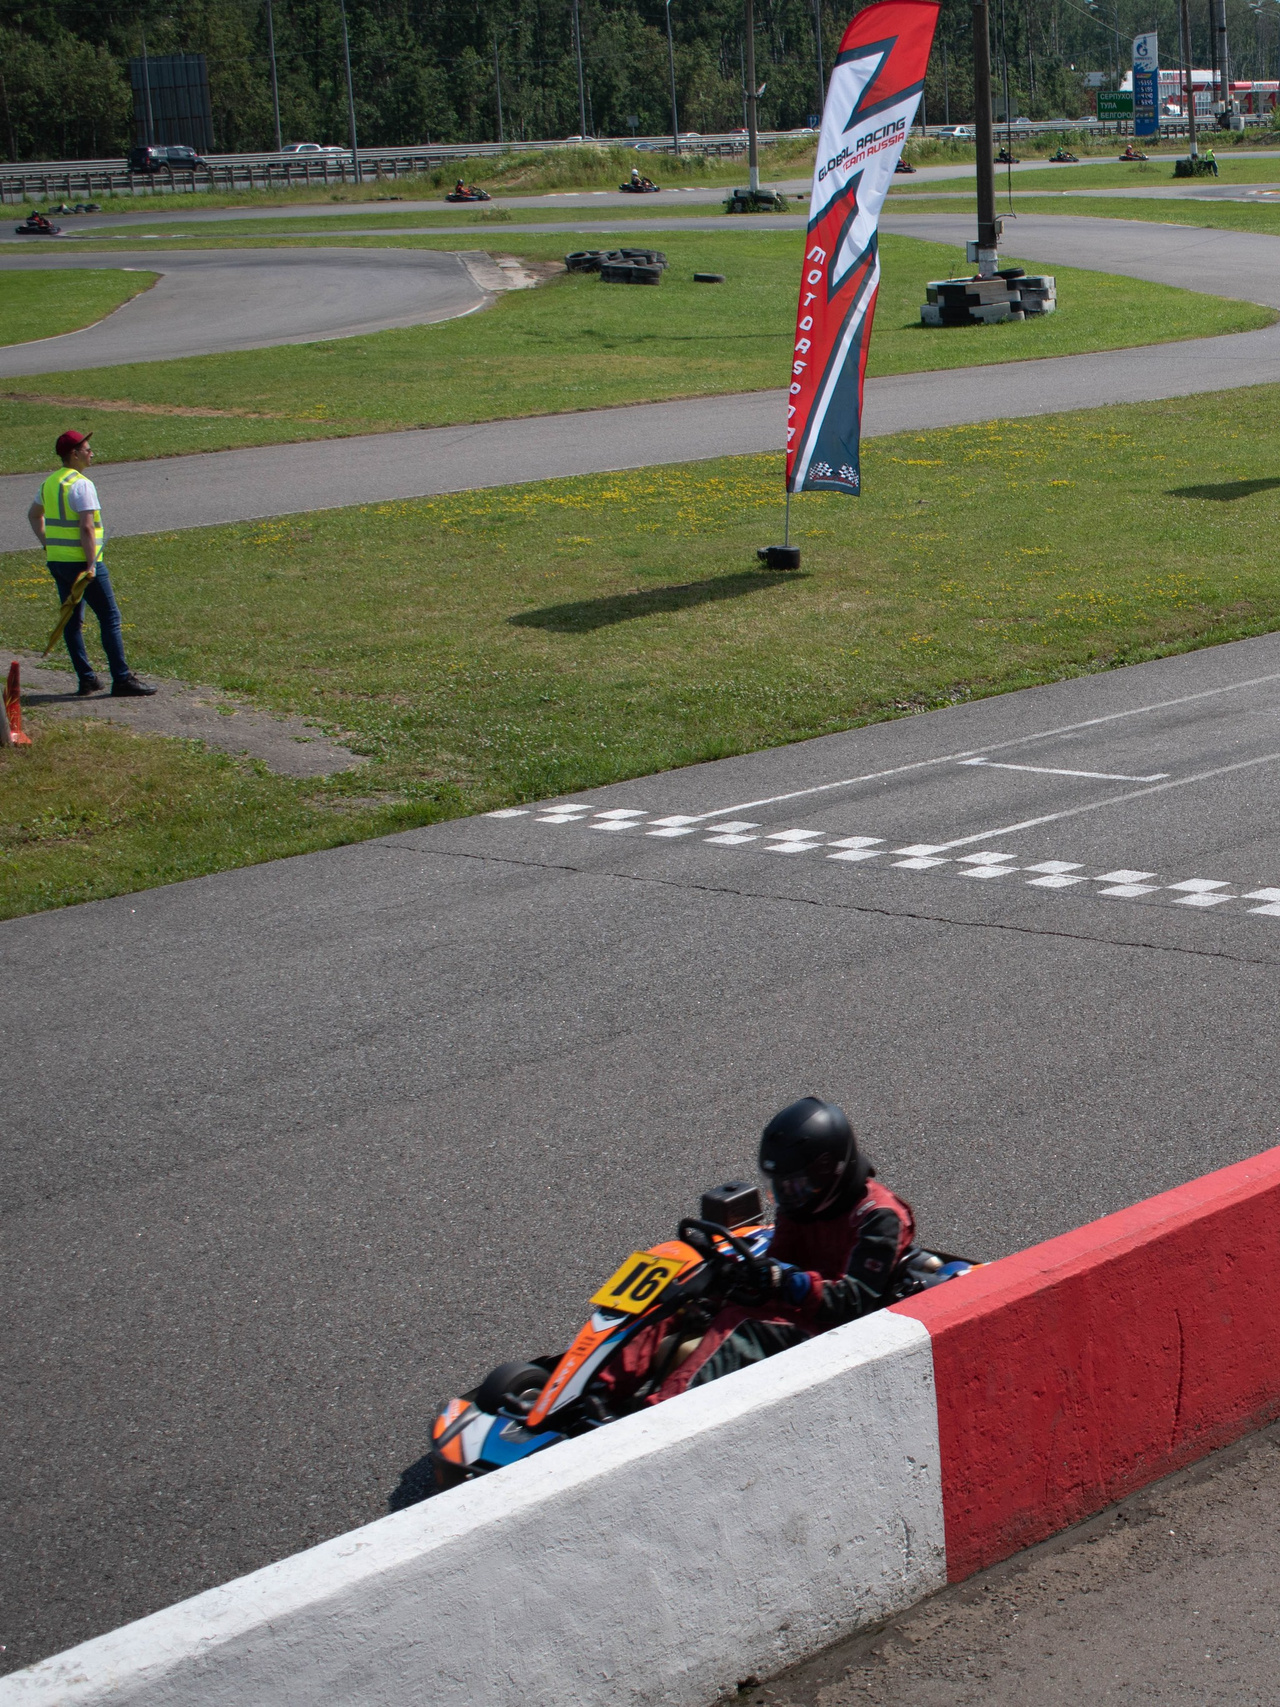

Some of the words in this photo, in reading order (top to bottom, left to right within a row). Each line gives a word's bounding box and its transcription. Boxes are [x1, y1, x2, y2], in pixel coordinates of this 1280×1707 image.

[818, 146, 855, 182] GLOBAL
[856, 116, 907, 152] RACING
[842, 151, 866, 173] TEAM
[866, 131, 905, 157] RUSSIA
[609, 1261, 670, 1302] 16
